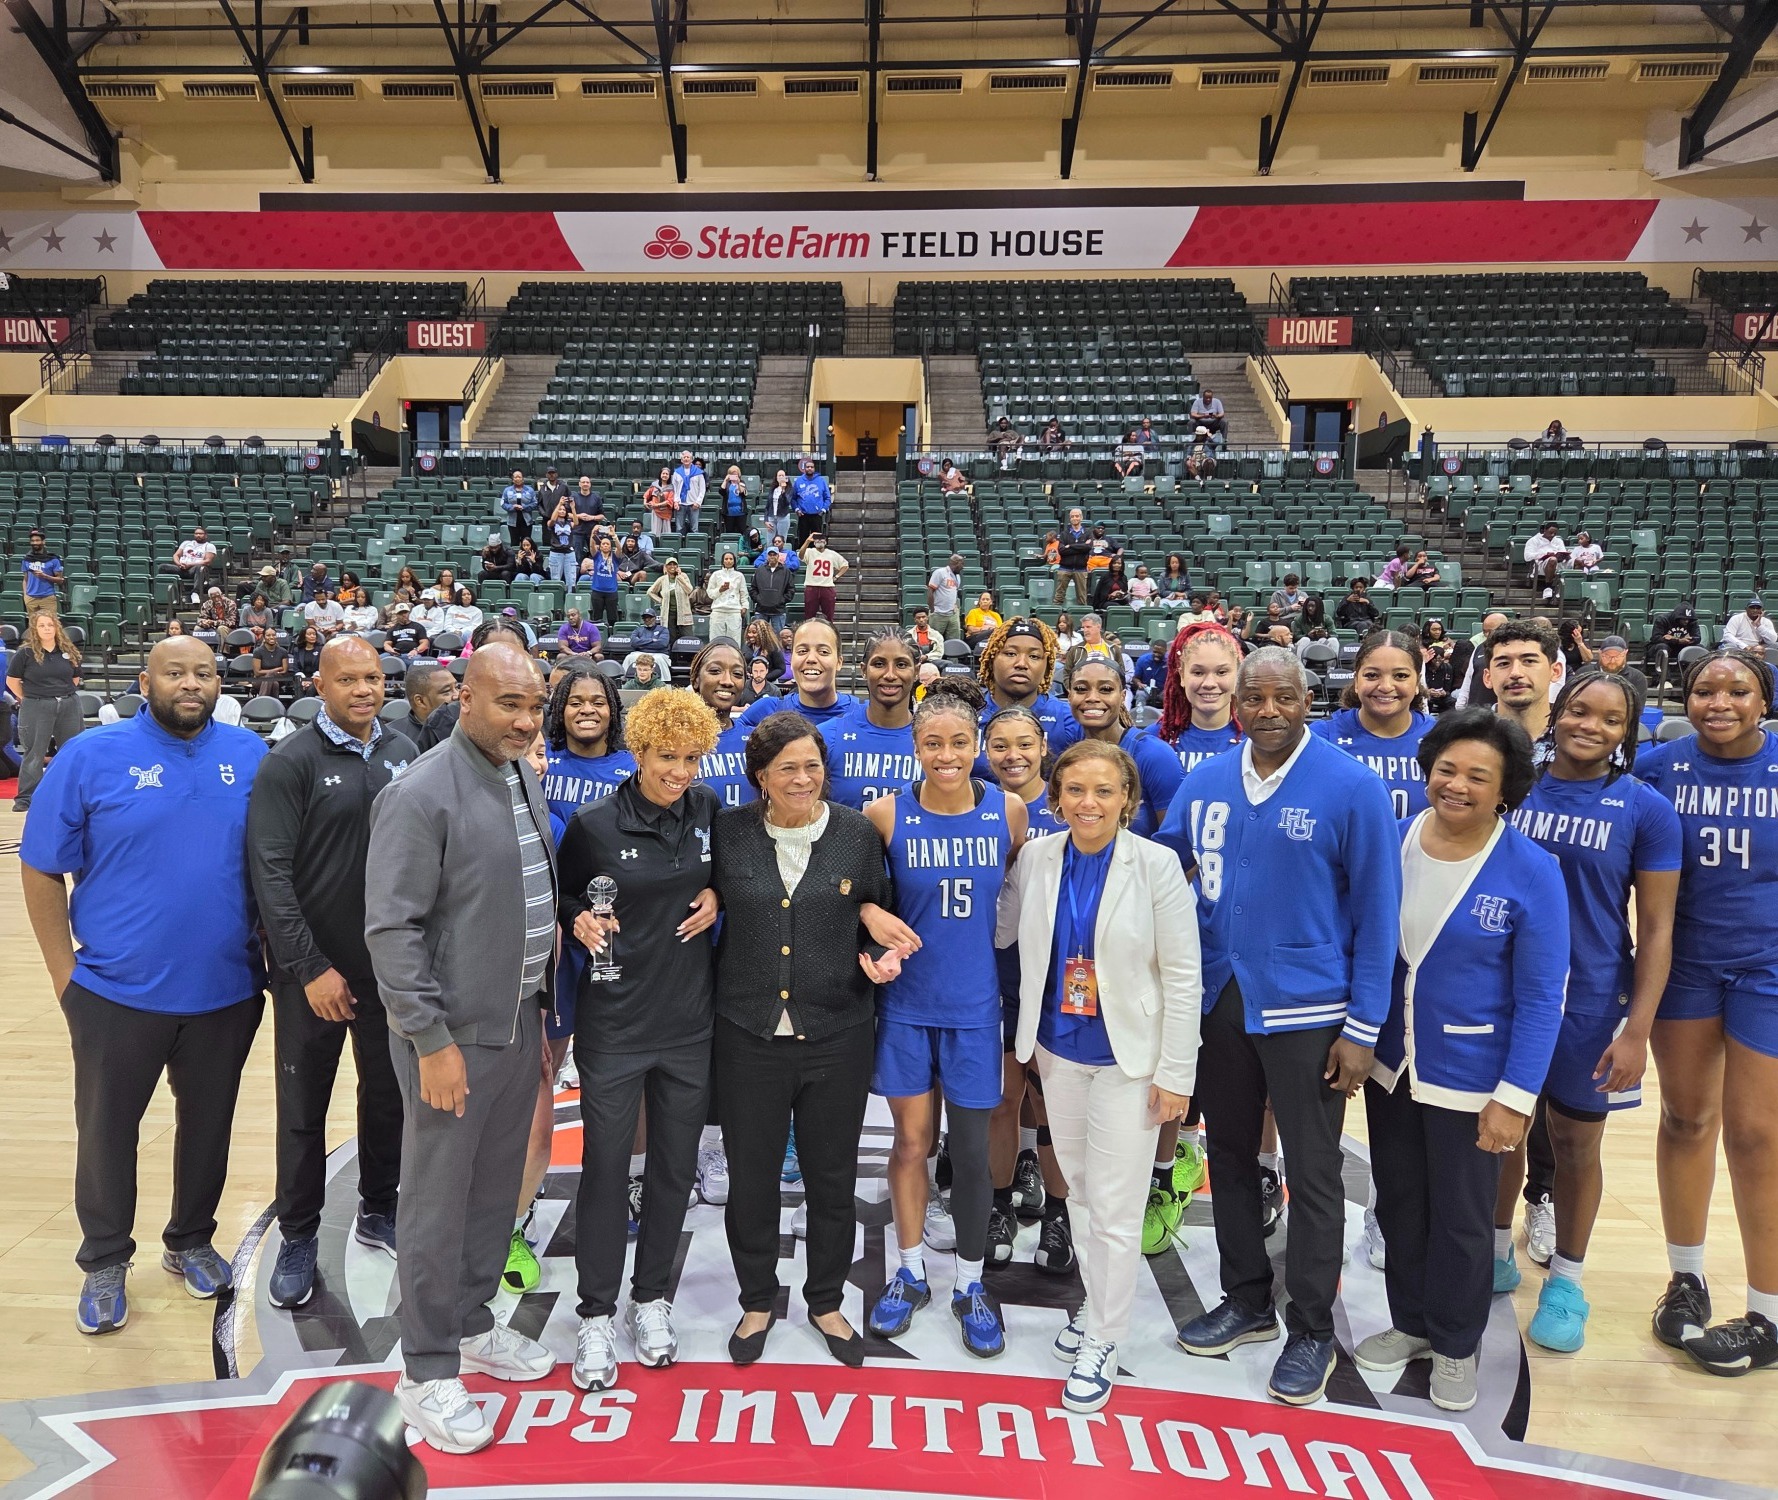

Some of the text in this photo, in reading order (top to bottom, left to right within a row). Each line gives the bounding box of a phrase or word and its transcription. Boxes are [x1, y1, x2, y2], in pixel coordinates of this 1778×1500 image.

[880, 230, 978, 258] FIELD
[990, 229, 1104, 257] HOUSE
[4, 319, 58, 343] HOME
[417, 323, 475, 347] GUEST
[1282, 319, 1339, 344] HOME
[1744, 315, 1778, 340] GUE
[812, 559, 831, 577] 29
[614, 768, 631, 777] CAA
[844, 752, 923, 781] HAMPTON
[544, 774, 619, 804] HAMPTO
[726, 784, 740, 807] 4
[1600, 797, 1624, 808] CAA
[981, 812, 999, 820] CAA
[1277, 807, 1317, 842] HU
[1510, 808, 1613, 852] HAMPTON
[906, 837, 998, 868] HAMPTON
[1699, 826, 1750, 870] 34
[939, 878, 973, 918] 15
[1470, 893, 1510, 933] HU
